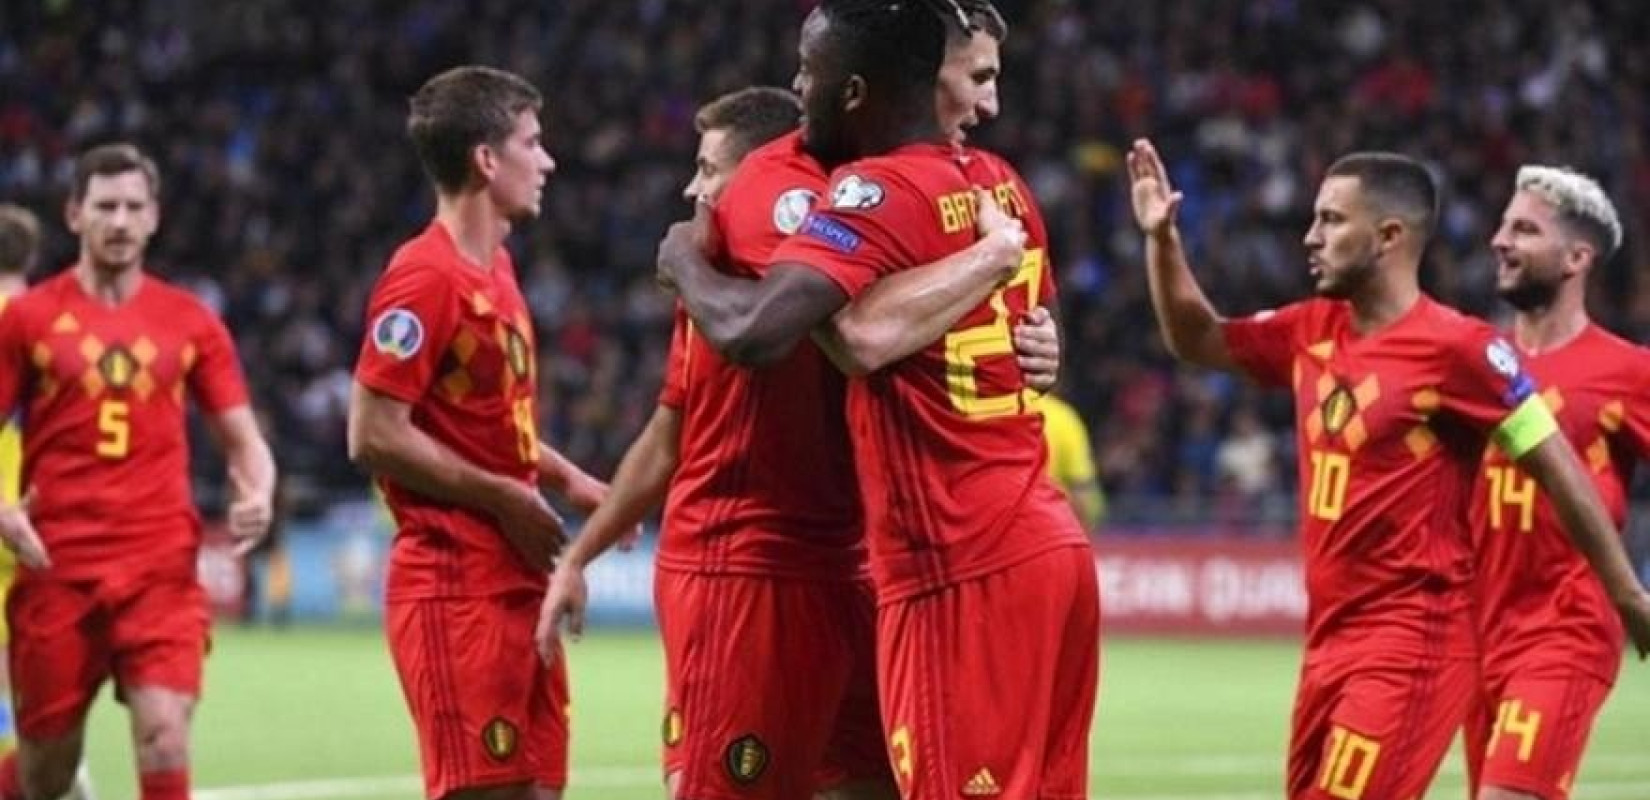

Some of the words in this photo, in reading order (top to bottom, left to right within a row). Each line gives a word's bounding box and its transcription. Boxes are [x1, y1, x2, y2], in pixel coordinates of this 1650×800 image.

[96, 399, 131, 459] 5
[1309, 450, 1351, 521] 10
[1485, 465, 1537, 532] 14
[1319, 724, 1381, 800] 10
[1486, 698, 1541, 762] 14
